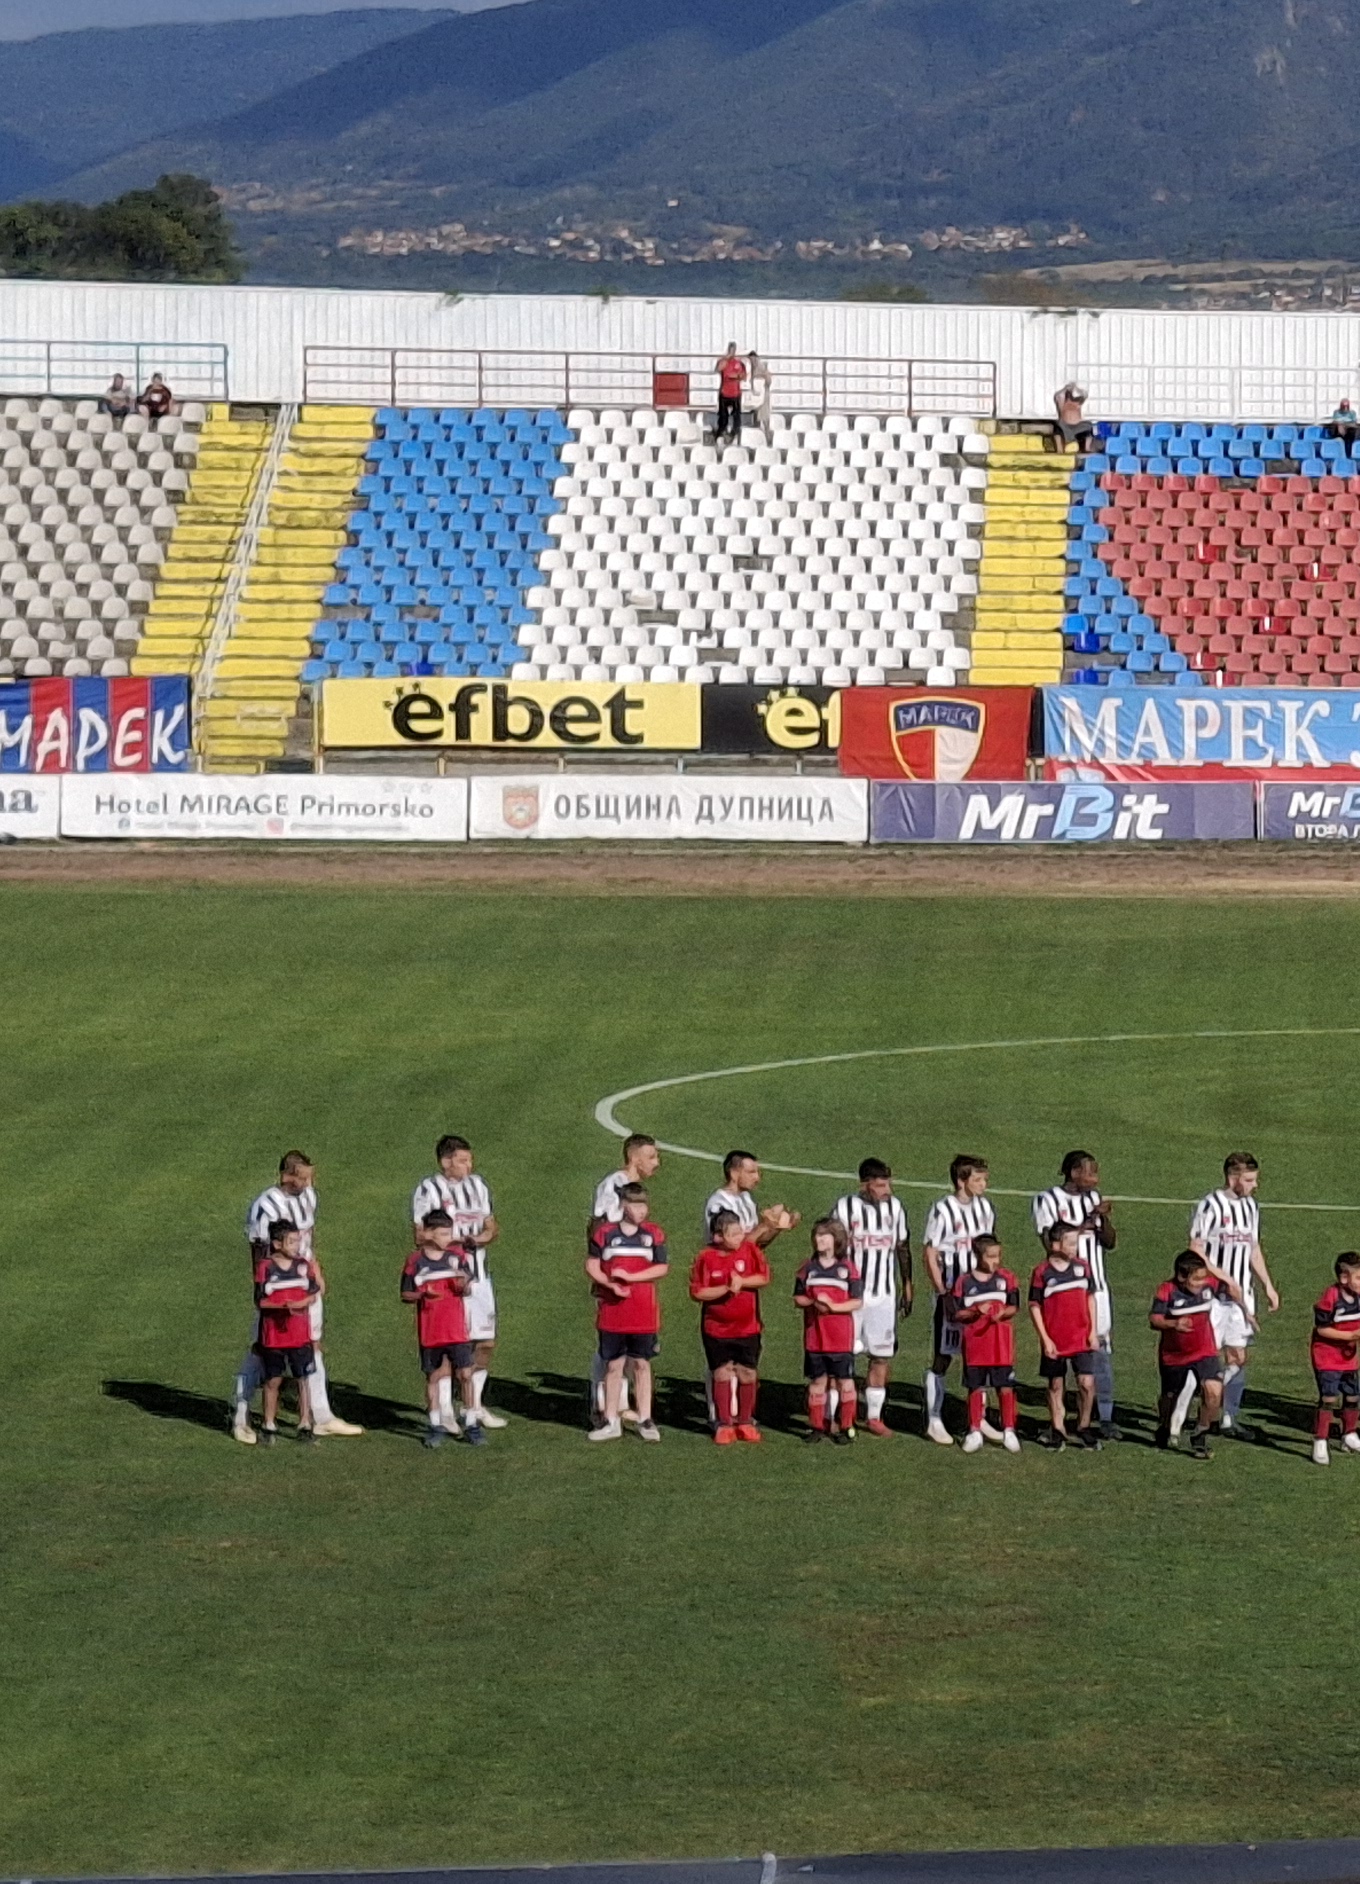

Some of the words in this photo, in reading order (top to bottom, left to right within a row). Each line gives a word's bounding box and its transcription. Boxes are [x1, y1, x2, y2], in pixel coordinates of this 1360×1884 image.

[0, 703, 185, 772] МАРЕК
[391, 685, 645, 744] efbet
[897, 705, 976, 729] МАРЕК
[1061, 697, 1332, 767] МАРЕК
[95, 792, 168, 816] Hotel
[180, 793, 288, 816] MIRAGE
[301, 795, 434, 819] Primorsko
[554, 794, 681, 824] ОБЩИНА
[695, 794, 834, 827] ДУПНИЦА
[959, 785, 1169, 840] MrBit
